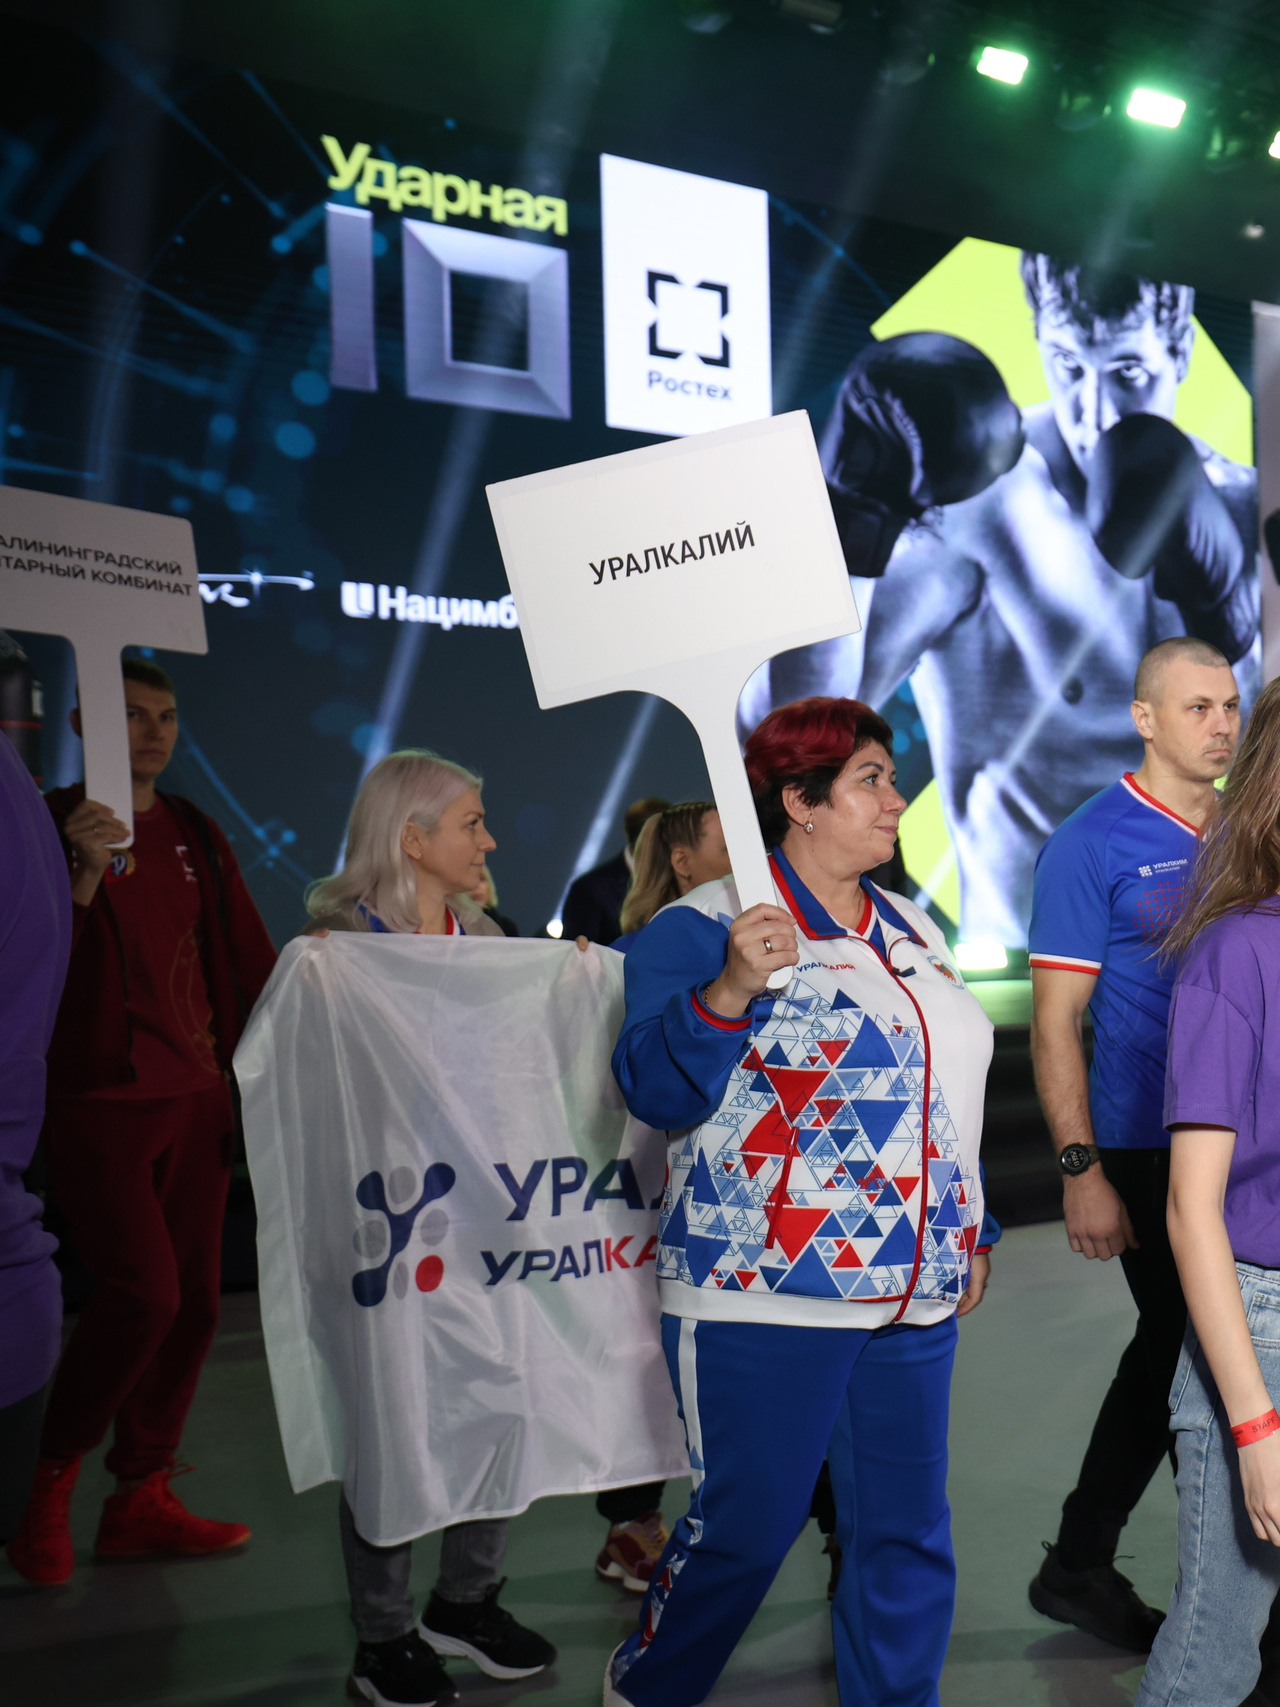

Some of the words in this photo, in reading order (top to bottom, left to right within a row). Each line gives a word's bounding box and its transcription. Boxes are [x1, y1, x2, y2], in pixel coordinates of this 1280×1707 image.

[320, 134, 568, 236] Ударная
[646, 369, 734, 401] Ростех
[588, 520, 756, 585] УРАЛКАЛИЙ
[0, 554, 86, 580] ТАРНЫЙ
[91, 569, 193, 597] КОМБИНАТ
[1251, 1416, 1276, 1433] STAFF
